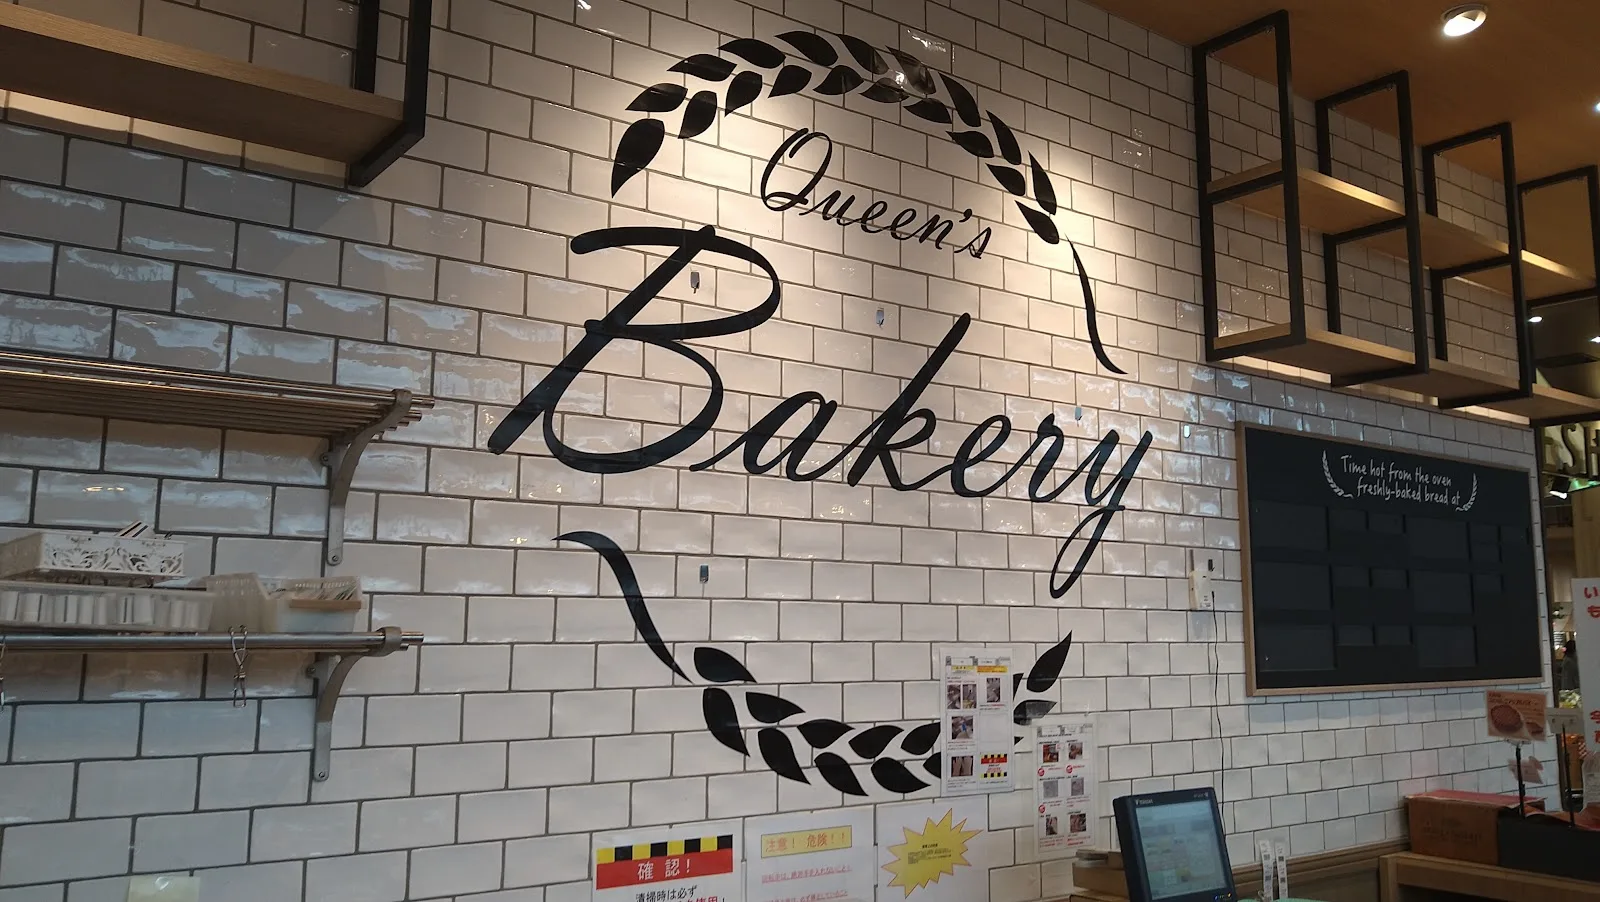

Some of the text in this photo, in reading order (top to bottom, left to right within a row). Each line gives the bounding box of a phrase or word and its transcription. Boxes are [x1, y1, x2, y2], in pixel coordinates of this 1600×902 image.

[760, 128, 992, 259] Queen's
[487, 225, 1153, 599] Bakery
[1341, 454, 1451, 487] Time hot from the oven
[1357, 476, 1461, 505] freshly-baked bread at
